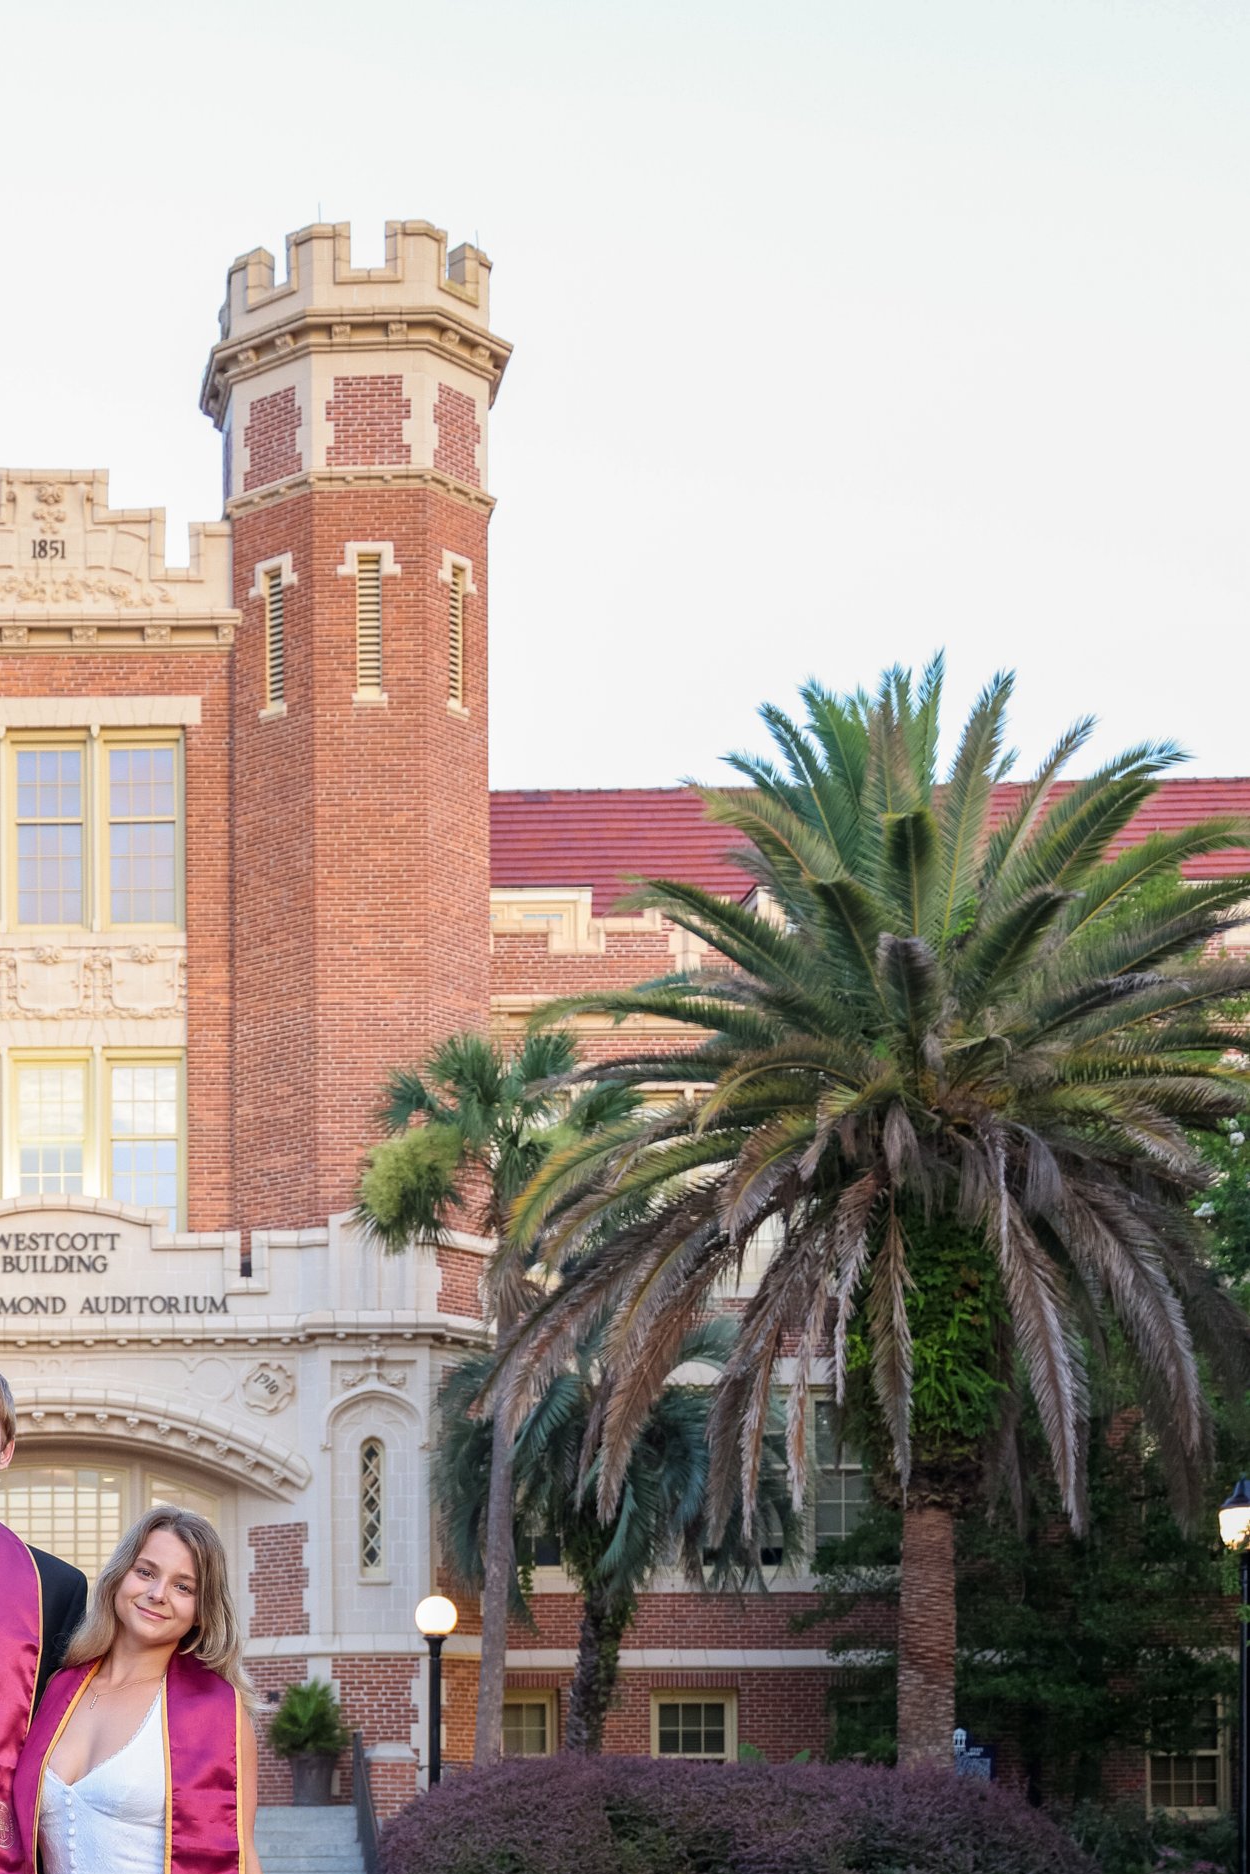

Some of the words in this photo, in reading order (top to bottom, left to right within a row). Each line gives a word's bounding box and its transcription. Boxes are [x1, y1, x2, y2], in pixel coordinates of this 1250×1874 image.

[31, 539, 66, 560] 1851
[1, 1255, 109, 1275] BUILDING
[80, 1294, 230, 1314] AUDITORIUM
[253, 1372, 279, 1395] 1910
